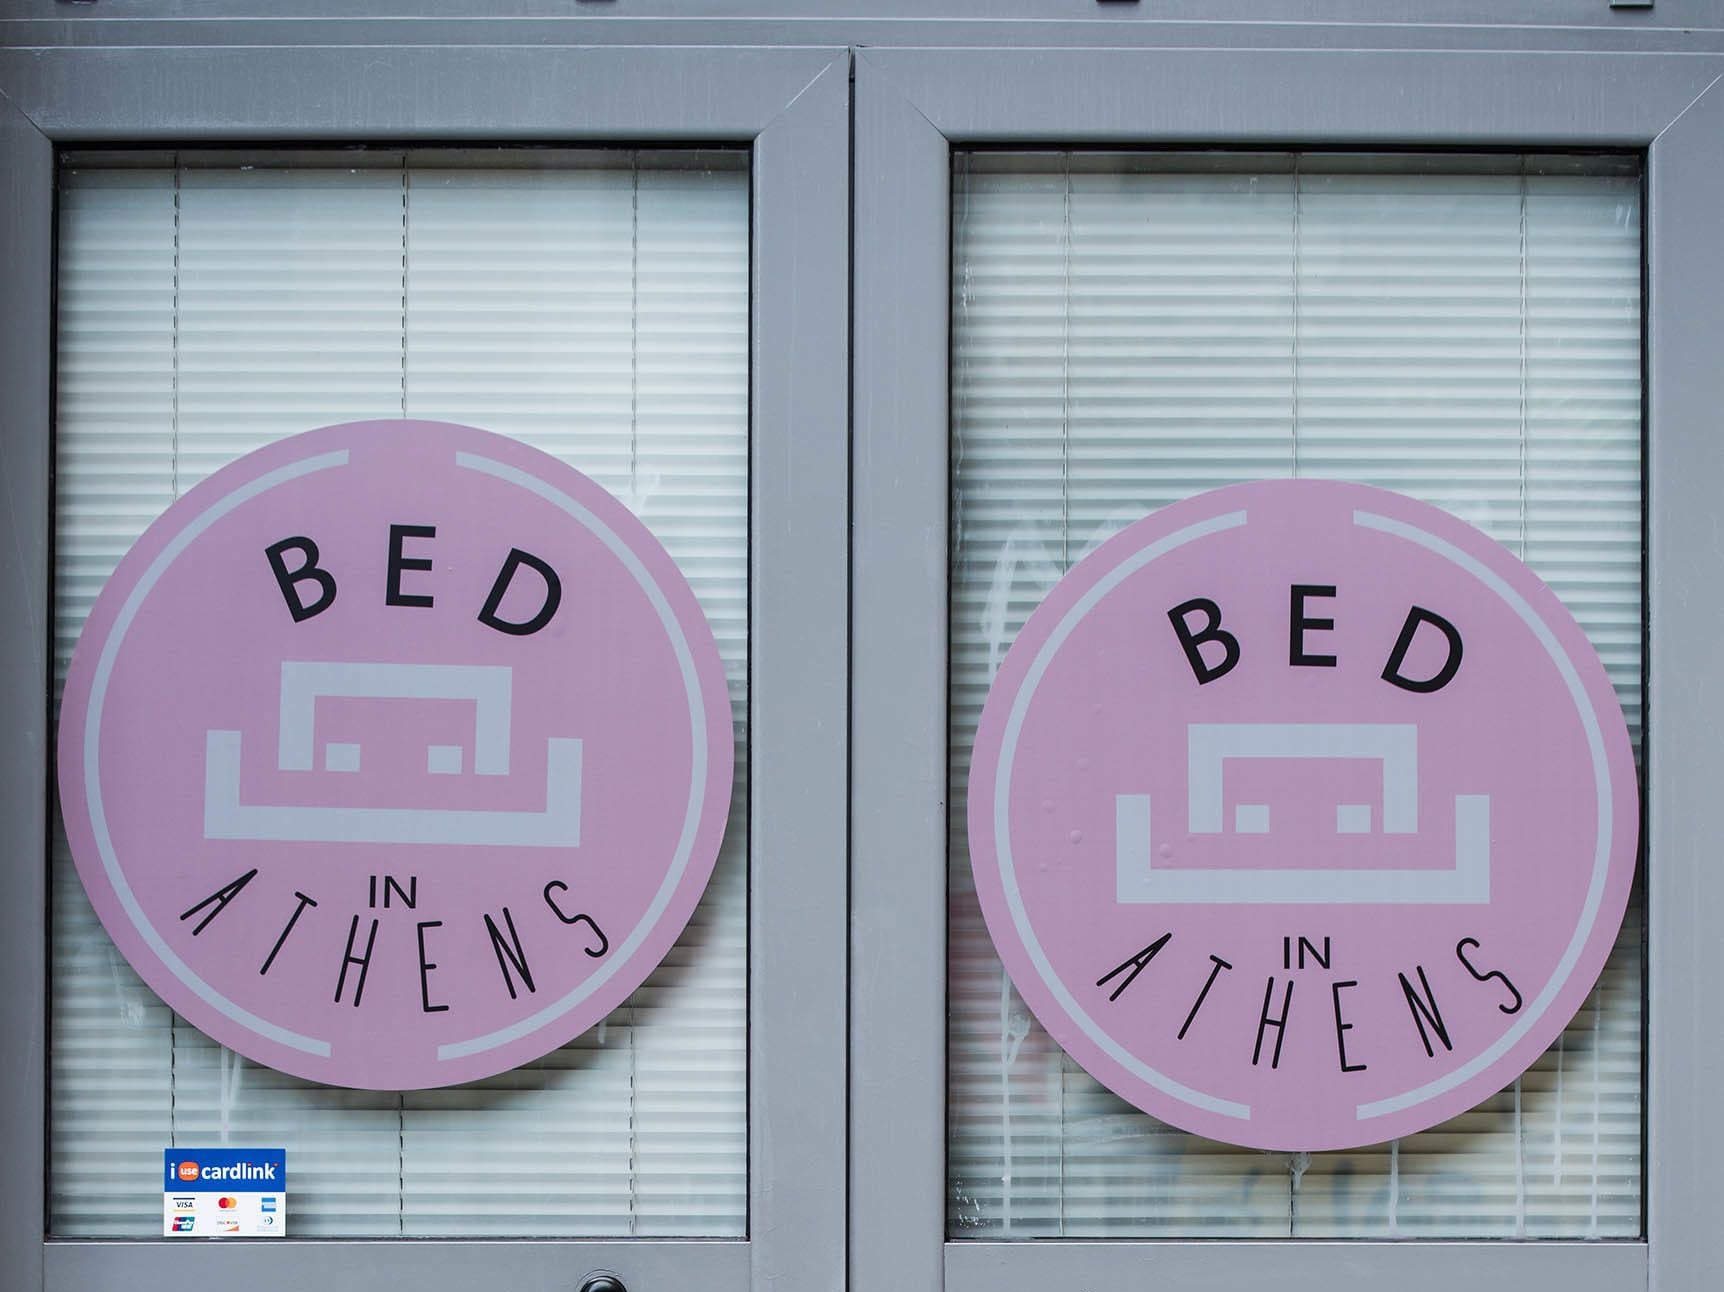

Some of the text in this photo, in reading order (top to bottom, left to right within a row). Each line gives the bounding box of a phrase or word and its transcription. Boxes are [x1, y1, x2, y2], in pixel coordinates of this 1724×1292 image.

[264, 523, 563, 636] BED
[1166, 583, 1464, 694] BED
[179, 867, 610, 1013] ATHENS
[368, 874, 417, 909] IN
[1095, 931, 1522, 1073] ATHENS
[1282, 935, 1332, 970] IN
[181, 1167, 198, 1175] use
[201, 1162, 276, 1180] cardlink
